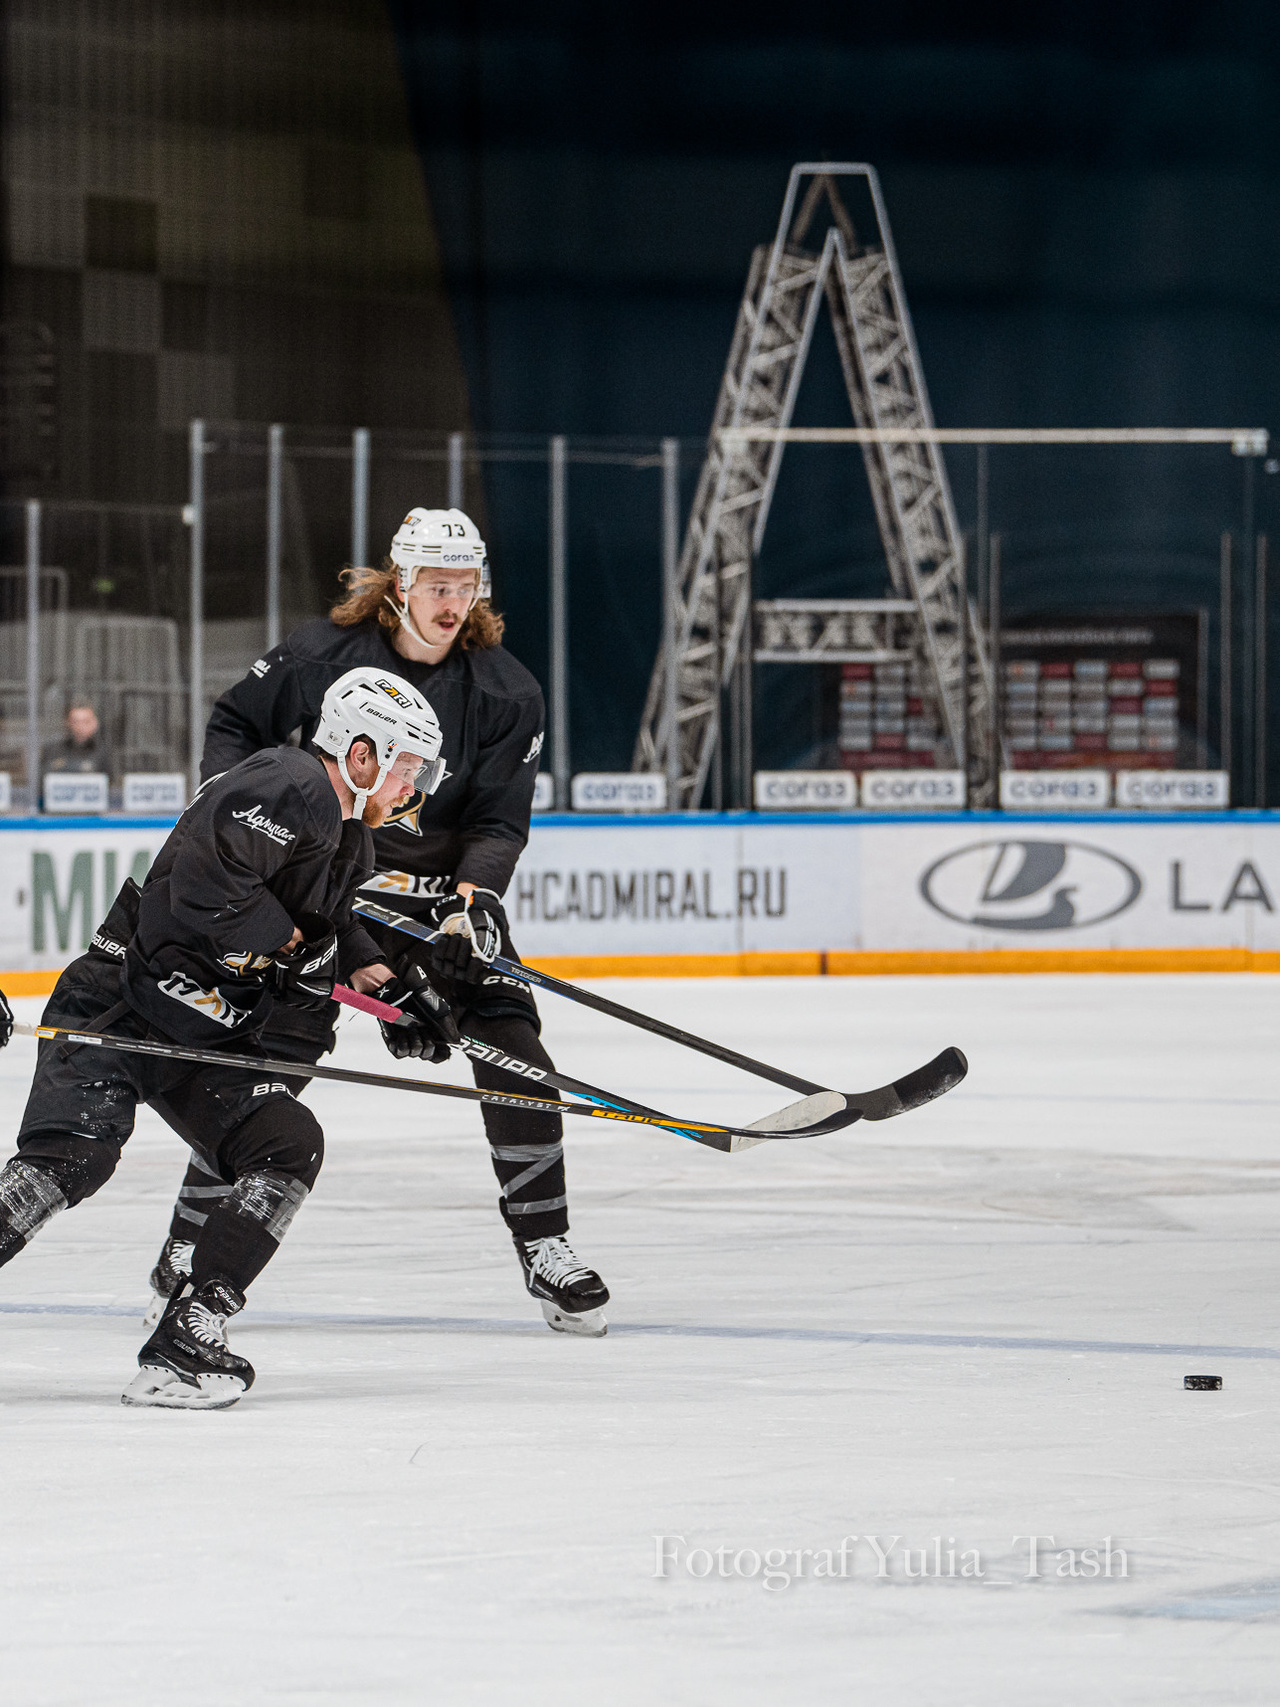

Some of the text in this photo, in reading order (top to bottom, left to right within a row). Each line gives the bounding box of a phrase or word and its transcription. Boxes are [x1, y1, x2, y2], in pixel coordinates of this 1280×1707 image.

[442, 524, 466, 537] 73
[516, 869, 787, 923] HCADMIRAL.RU
[482, 975, 531, 994] CCM
[481, 1094, 552, 1111] CATALYST
